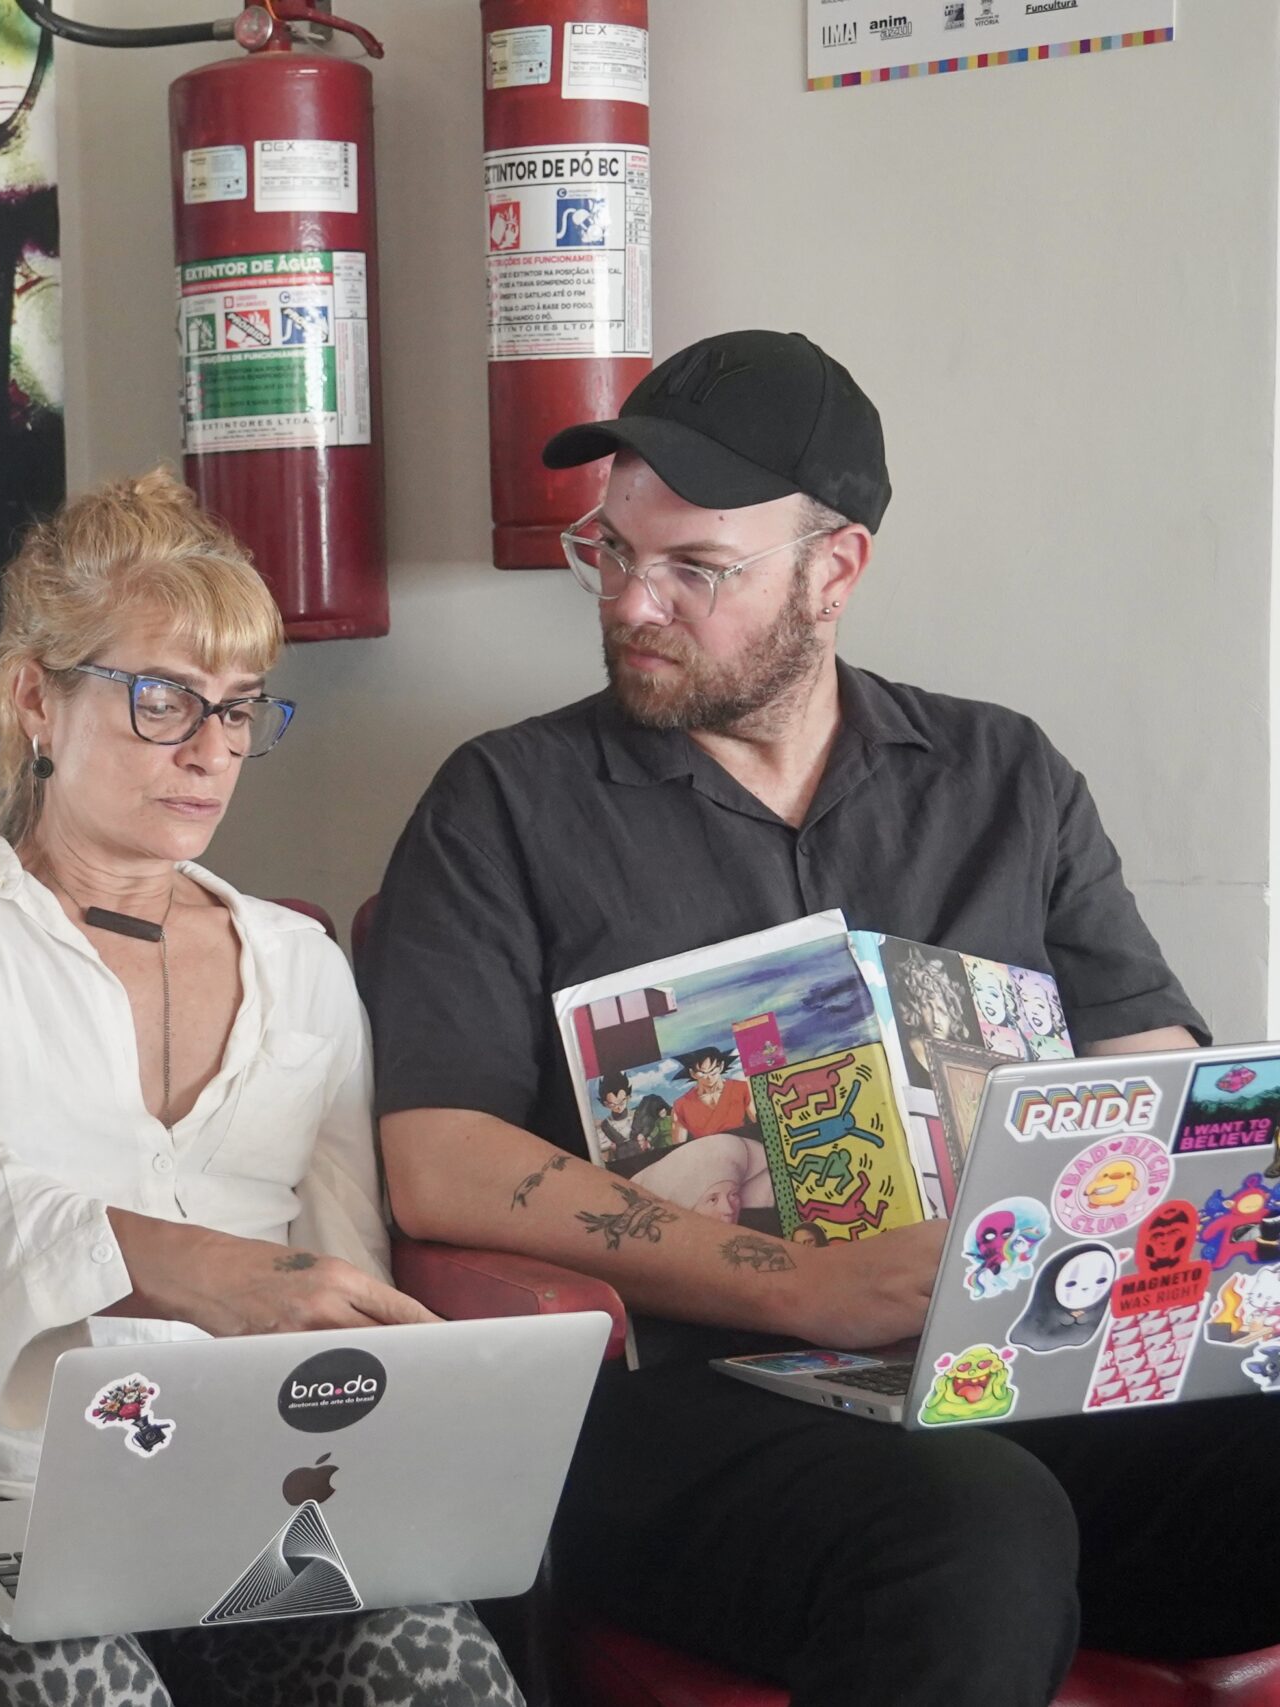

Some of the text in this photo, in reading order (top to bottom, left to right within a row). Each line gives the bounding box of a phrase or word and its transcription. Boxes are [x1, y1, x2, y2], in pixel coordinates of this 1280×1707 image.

[1025, 0, 1077, 13] Funcultura
[869, 15, 907, 30] anim
[880, 21, 912, 40] azul
[542, 159, 564, 178] DE
[570, 151, 593, 177] PÓ
[598, 158, 619, 177] BC
[185, 256, 324, 281] EXTINTOR DE ÁGUA
[227, 313, 270, 345] PROIBIDO
[1018, 1083, 1156, 1135] PRIDE
[1180, 1130, 1266, 1150] BELIEVE
[1182, 1118, 1271, 1137] I WANT TO
[1061, 1135, 1168, 1187] BAD BITCH
[1071, 1213, 1128, 1235] CLUB
[1121, 1267, 1203, 1295] MAGNETO
[1120, 1283, 1201, 1312] WAS RIGHT
[290, 1374, 377, 1399] bra.da
